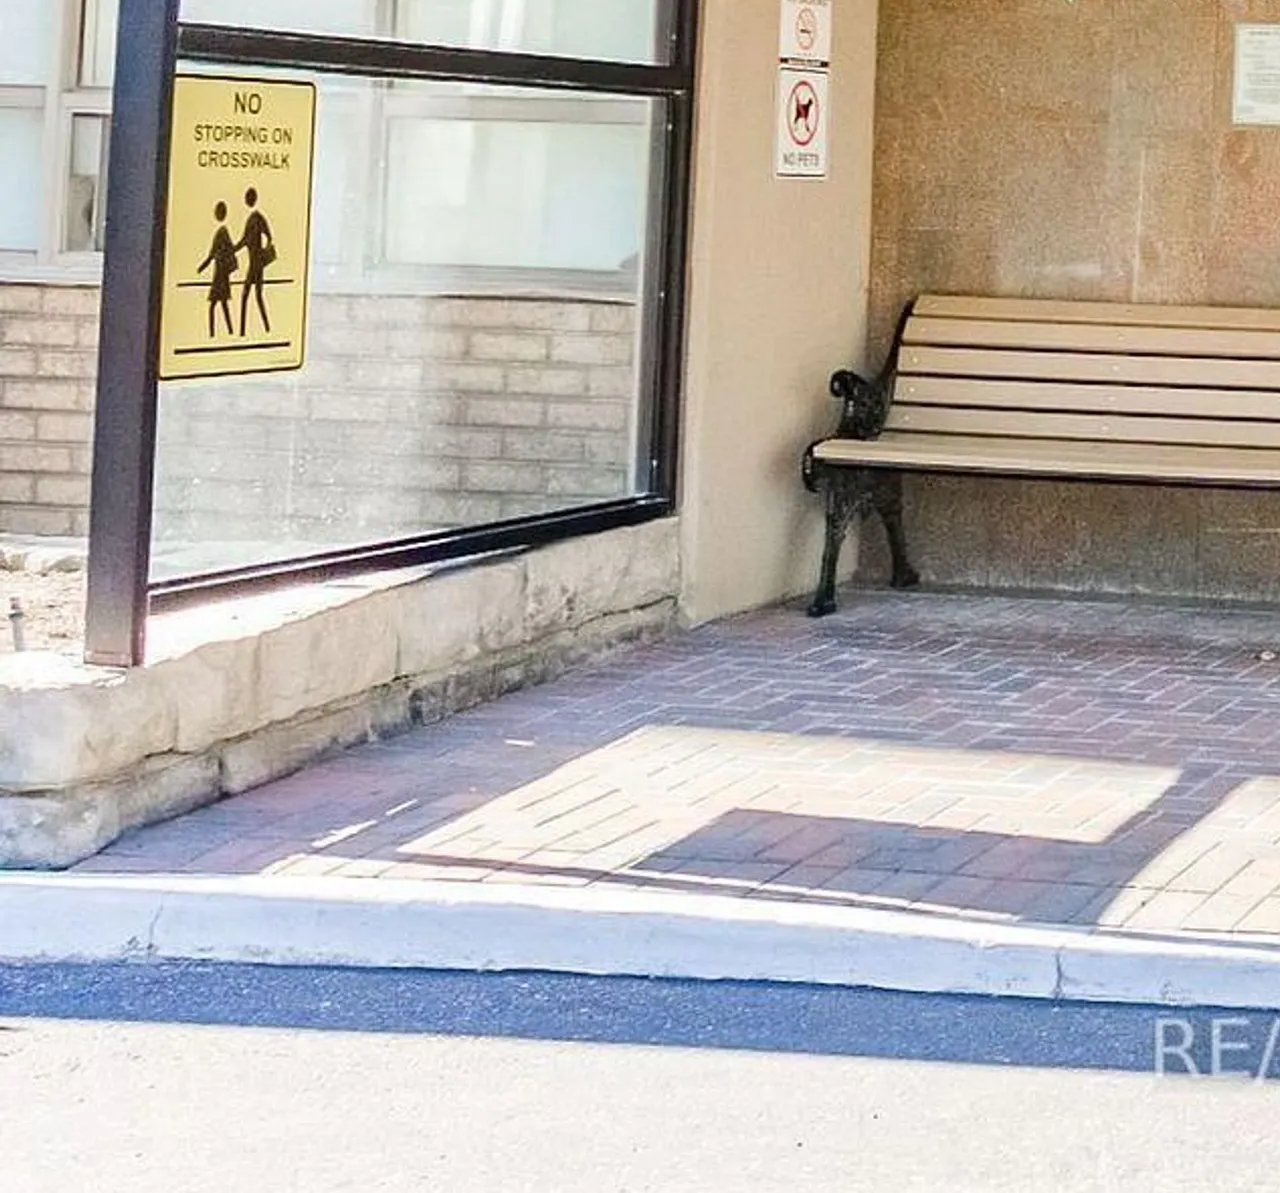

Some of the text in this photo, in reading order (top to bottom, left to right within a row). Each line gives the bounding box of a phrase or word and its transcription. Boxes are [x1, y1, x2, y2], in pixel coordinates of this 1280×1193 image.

[234, 92, 262, 114] NO
[194, 124, 293, 144] STOPPING ON
[198, 150, 290, 169] CROSSWALK
